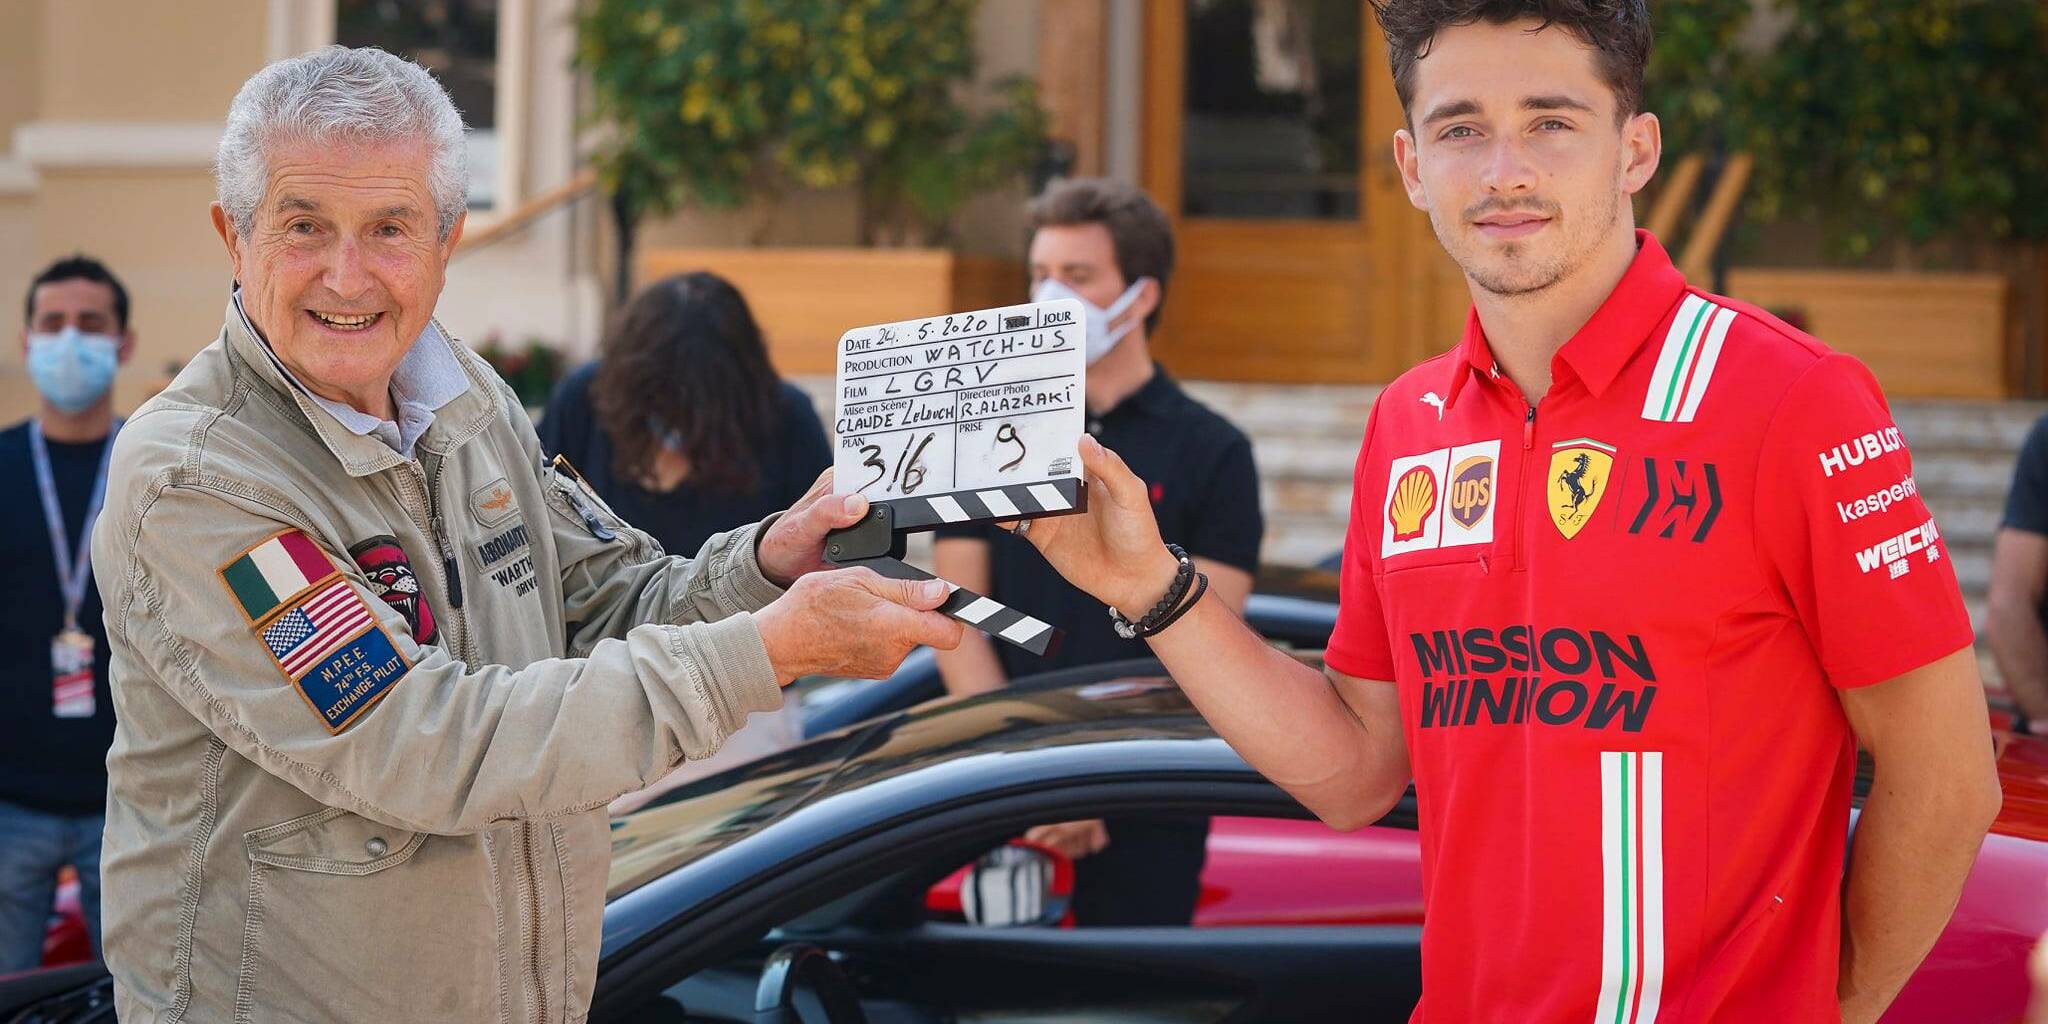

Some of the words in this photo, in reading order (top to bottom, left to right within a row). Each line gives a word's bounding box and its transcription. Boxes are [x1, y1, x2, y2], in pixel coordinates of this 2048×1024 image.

[1043, 311, 1072, 326] JOUR
[845, 338, 871, 351] DATE
[844, 354, 913, 373] PRODUCTION
[844, 386, 867, 399] FILM
[960, 388, 1001, 401] Directeur
[1003, 385, 1030, 396] Photo
[843, 404, 864, 416] Mise
[866, 404, 878, 414] en
[880, 400, 908, 412] Scène
[836, 413, 895, 434] CLAUDE
[959, 422, 983, 433] PRISE
[842, 437, 865, 448] PLAN
[996, 423, 1026, 472] 9
[1453, 477, 1490, 519] ups
[1410, 625, 1657, 682] MISSION
[326, 677, 375, 720] EXCHANGE
[372, 656, 401, 682] PILOT
